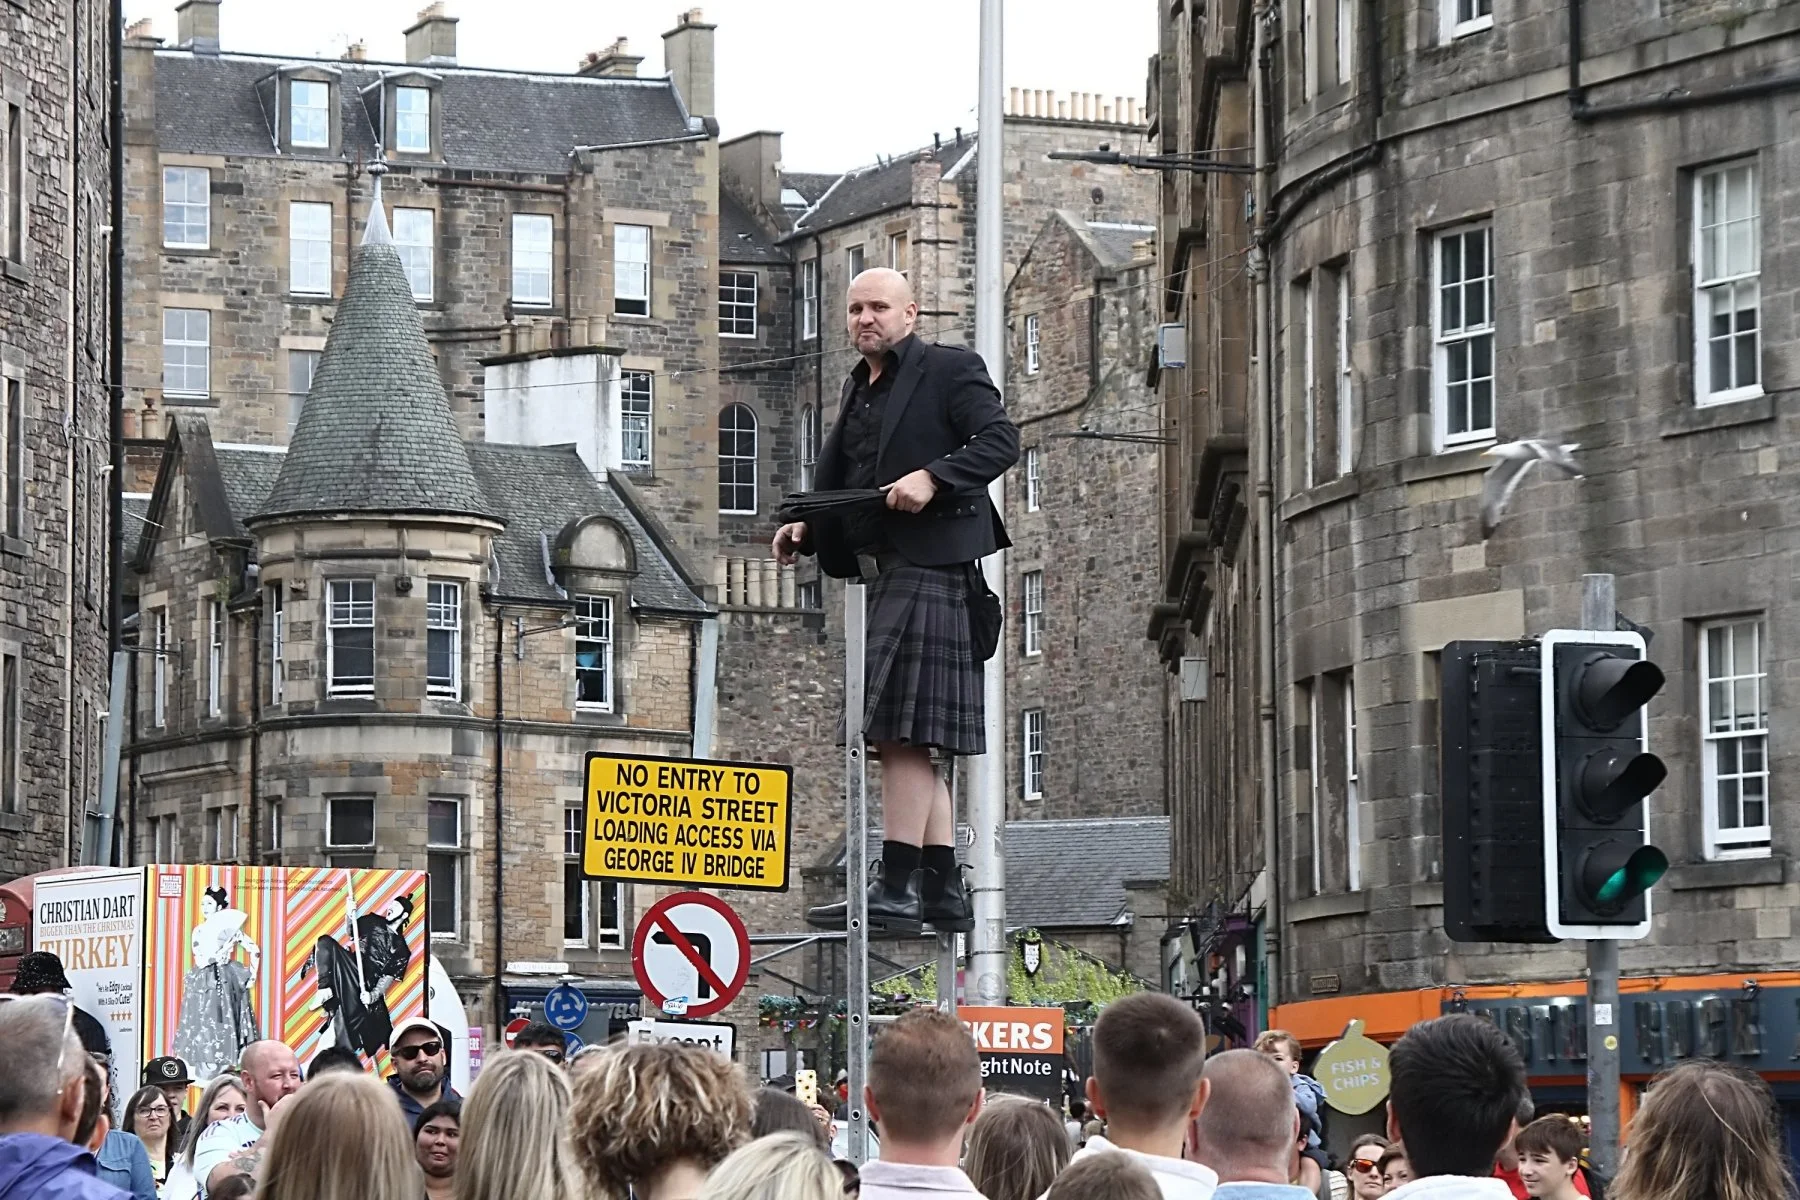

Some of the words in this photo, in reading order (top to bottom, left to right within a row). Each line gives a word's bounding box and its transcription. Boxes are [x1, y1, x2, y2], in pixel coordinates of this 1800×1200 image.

[616, 763, 649, 788] NO
[657, 766, 725, 792] ENTRY
[733, 771, 761, 796] TO
[597, 790, 693, 819] VICTORIA
[701, 797, 779, 824] STREET
[593, 818, 668, 846] LOADING
[674, 823, 744, 850] ACCESS
[750, 828, 777, 852] VIA
[604, 847, 675, 874] GEORGE
[681, 852, 697, 875] IV
[703, 853, 765, 879] BRIDGE
[40, 897, 100, 924] CHRISTIAN
[102, 895, 135, 919] DART
[40, 925, 63, 937] BIGGER
[64, 924, 82, 935] THAN
[83, 922, 96, 933] THE
[97, 920, 135, 932] CHRISTMAS
[40, 934, 134, 970] TURKEY
[109, 981, 120, 994] Edgy
[961, 1020, 1053, 1050] KERS
[980, 1056, 1008, 1077] ght
[1011, 1058, 1052, 1076] Note
[1331, 1058, 1367, 1074] FISH
[1370, 1056, 1382, 1069] &
[1332, 1072, 1381, 1091] CHIPS
